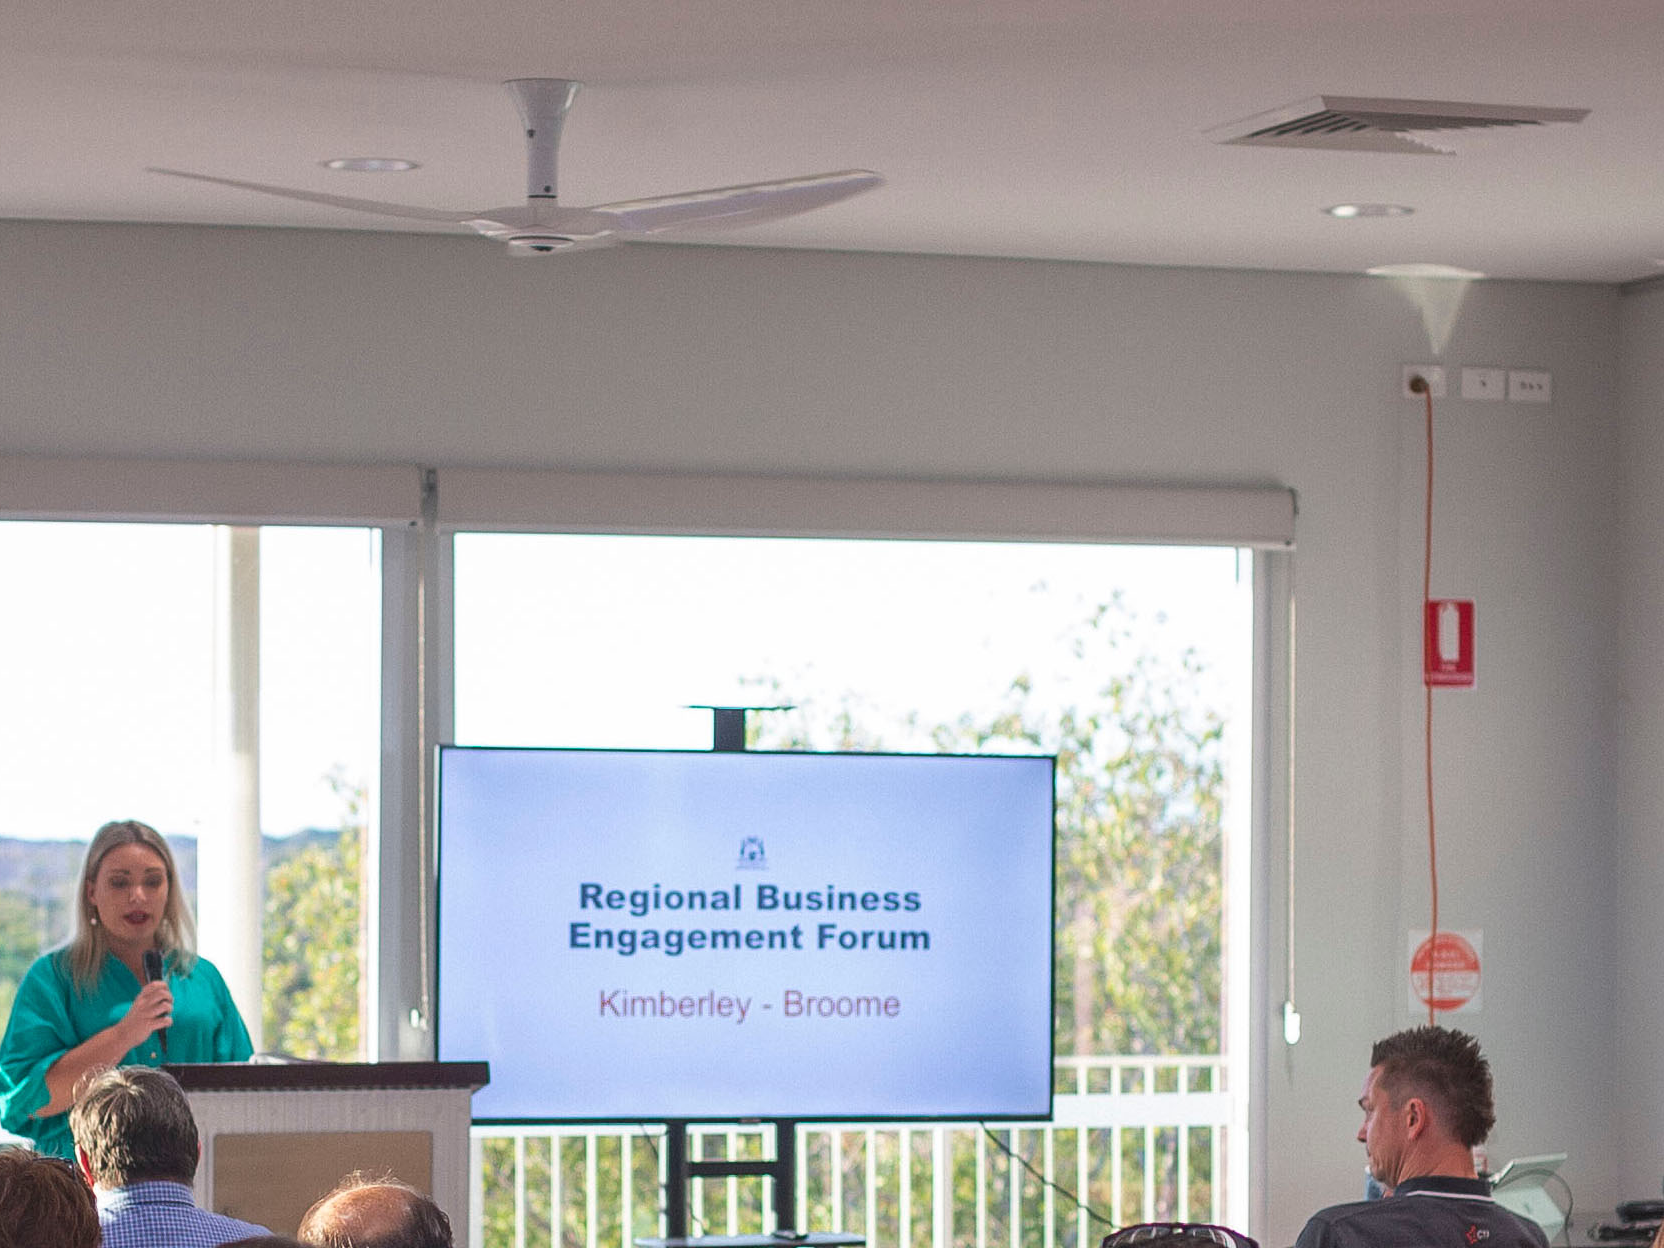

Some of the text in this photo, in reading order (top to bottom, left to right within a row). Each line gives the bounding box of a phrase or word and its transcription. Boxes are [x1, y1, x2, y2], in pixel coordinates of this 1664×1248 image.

[579, 882, 923, 917] Regional Business
[568, 922, 932, 957] Engagement Forum
[598, 989, 753, 1024] Kimberley
[784, 989, 902, 1019] Broome
